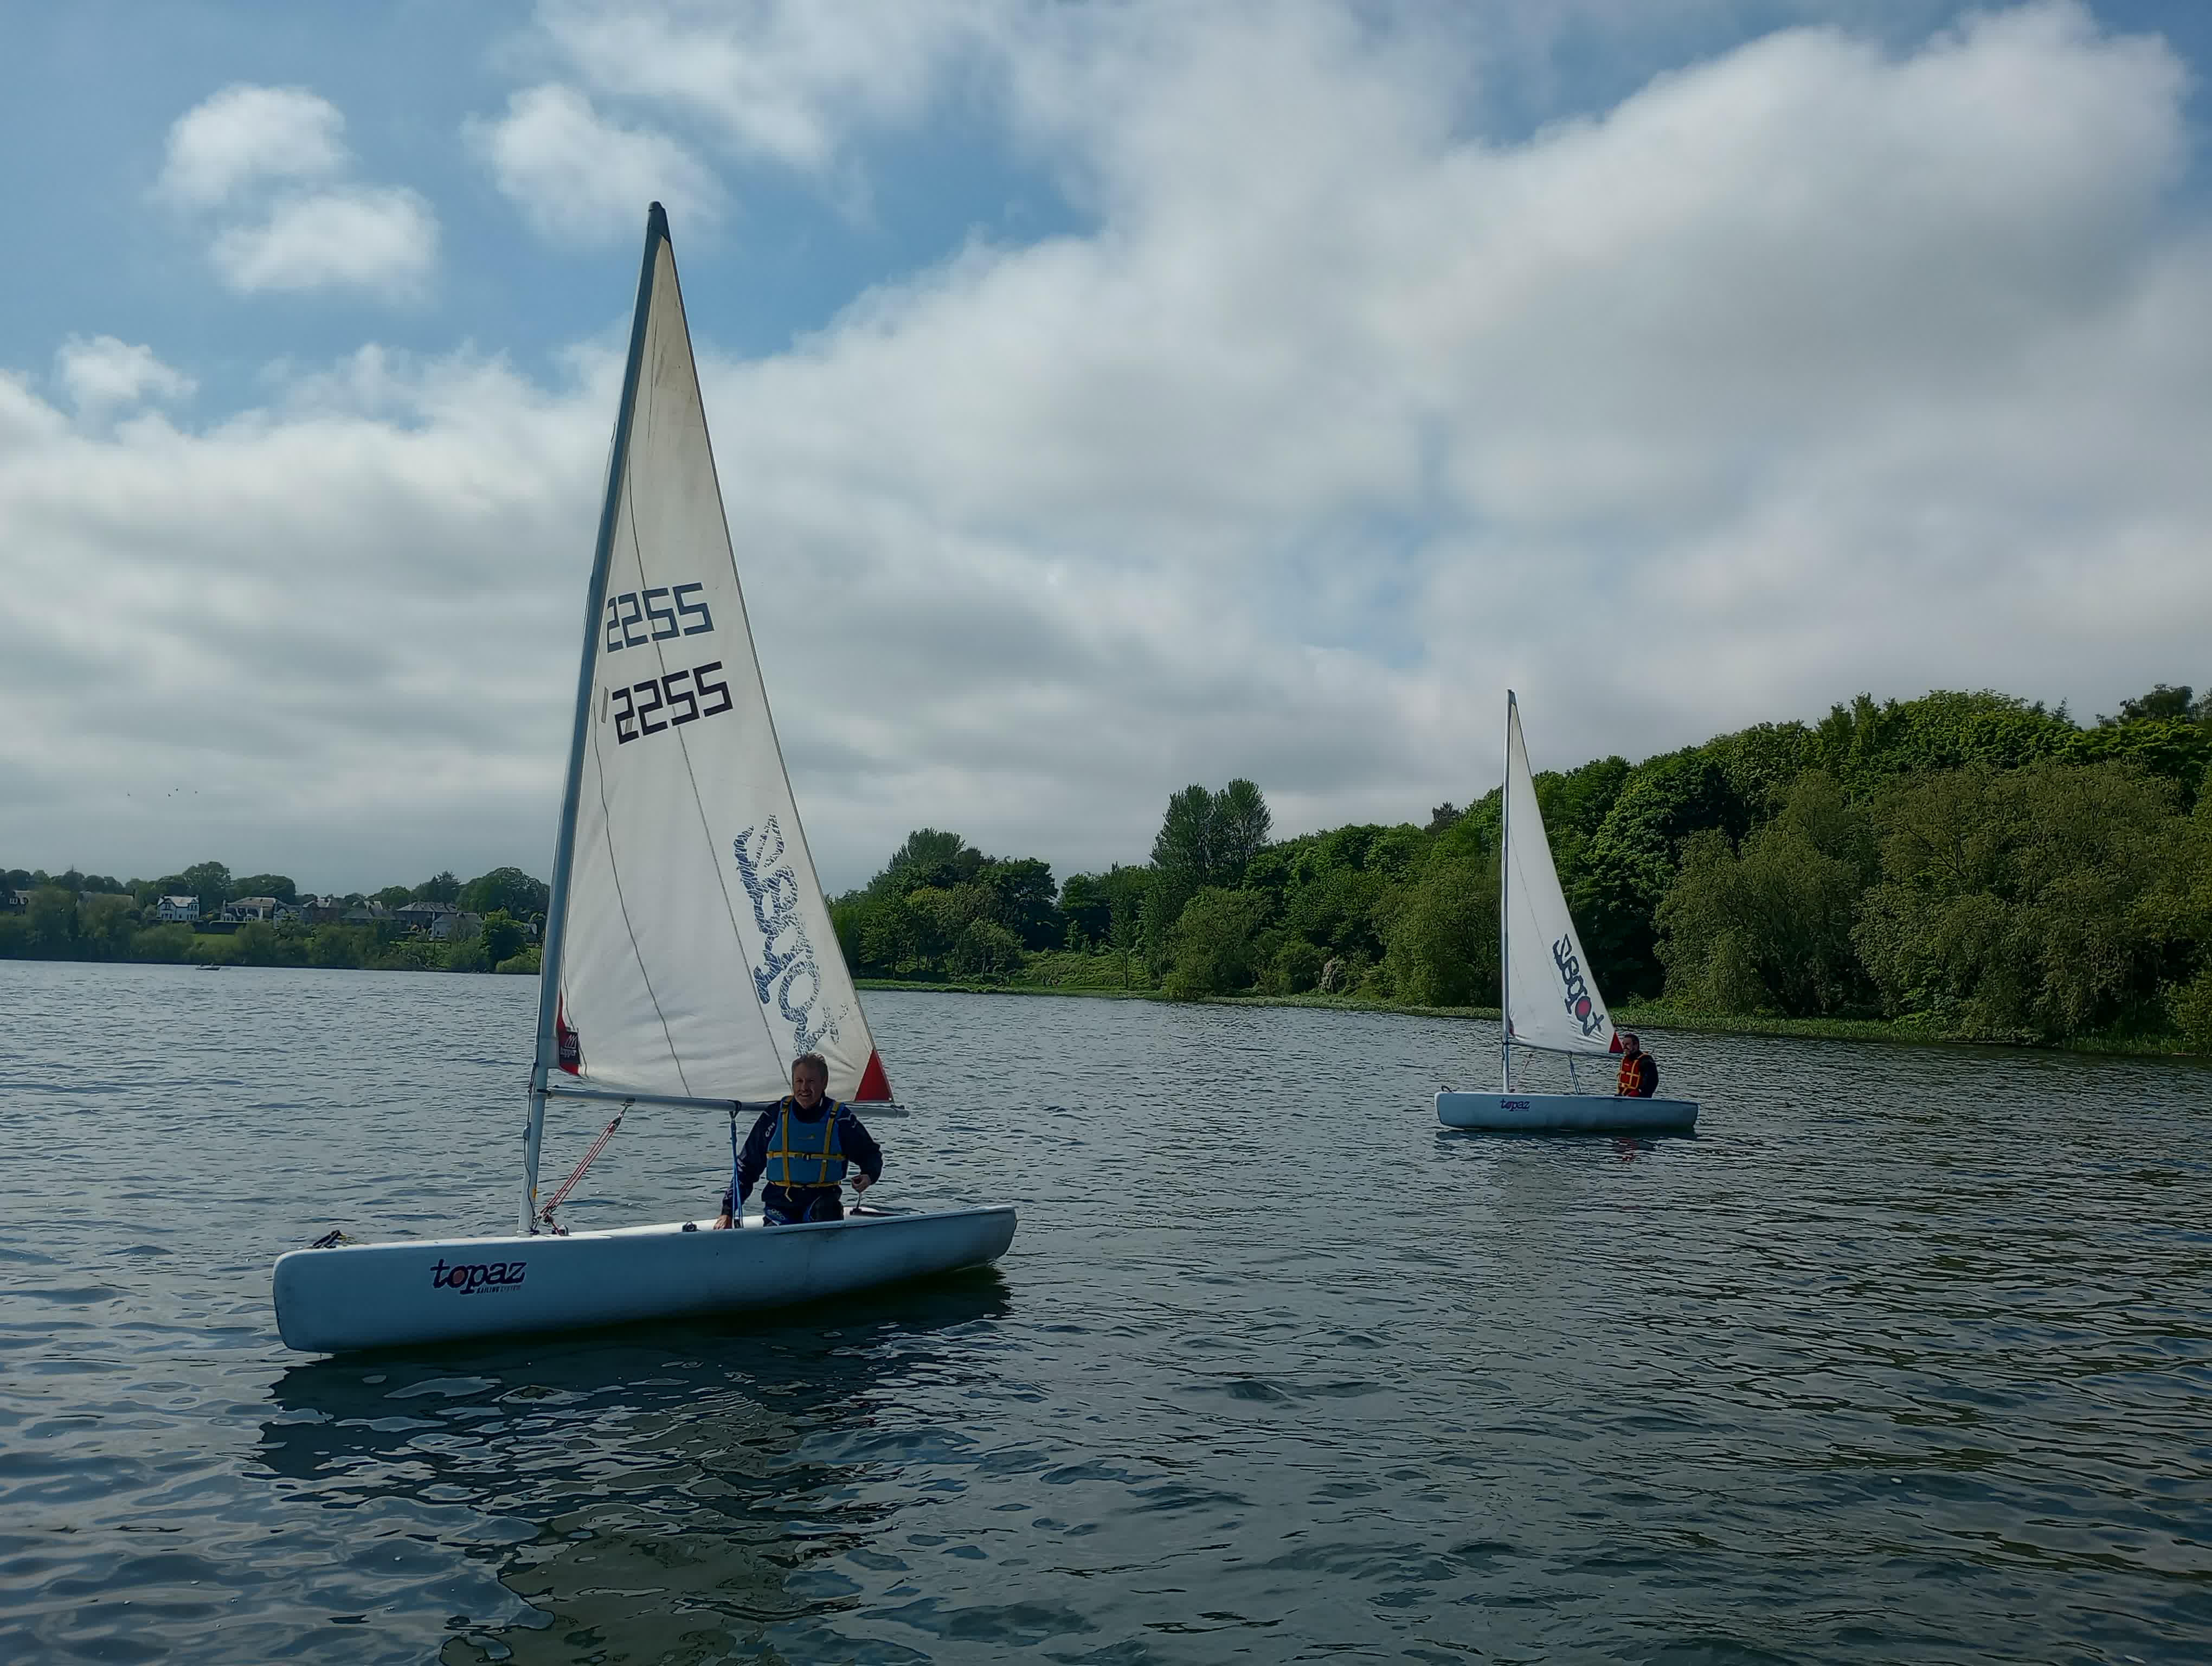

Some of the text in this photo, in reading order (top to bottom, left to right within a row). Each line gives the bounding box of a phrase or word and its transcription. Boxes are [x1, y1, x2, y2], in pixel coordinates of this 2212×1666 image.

[607, 582, 715, 653] 2255
[612, 661, 733, 746] 2255
[1501, 1098, 1530, 1112] topaz
[430, 1259, 527, 1295] topaz
